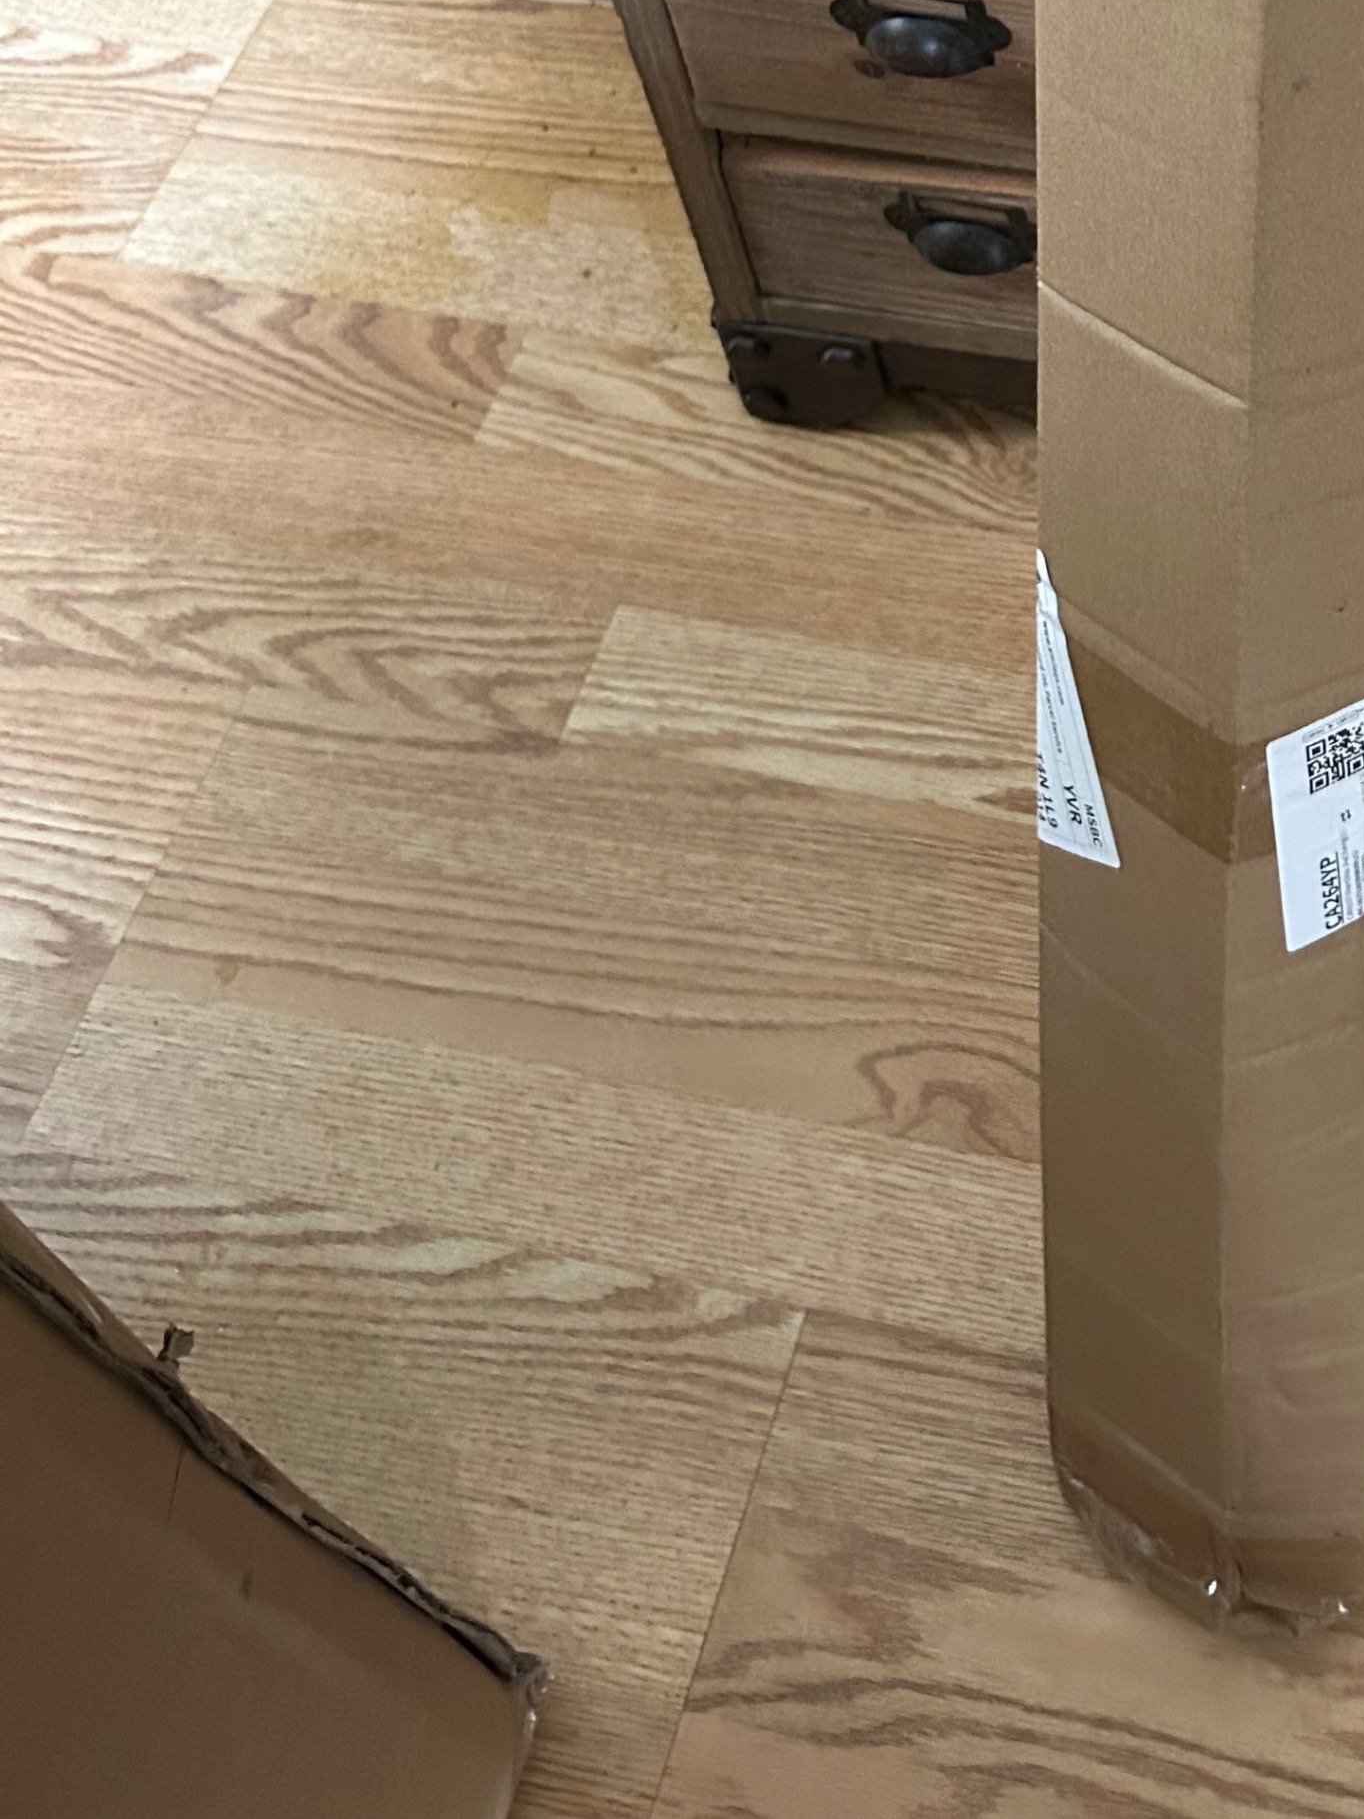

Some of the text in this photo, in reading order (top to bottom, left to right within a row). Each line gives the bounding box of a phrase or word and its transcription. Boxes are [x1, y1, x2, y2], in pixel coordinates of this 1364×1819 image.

[1042, 793, 1059, 829] 1L9
[1063, 784, 1082, 825] YVR
[1084, 803, 1103, 848] MSBC
[1319, 856, 1342, 930] CA264YP
